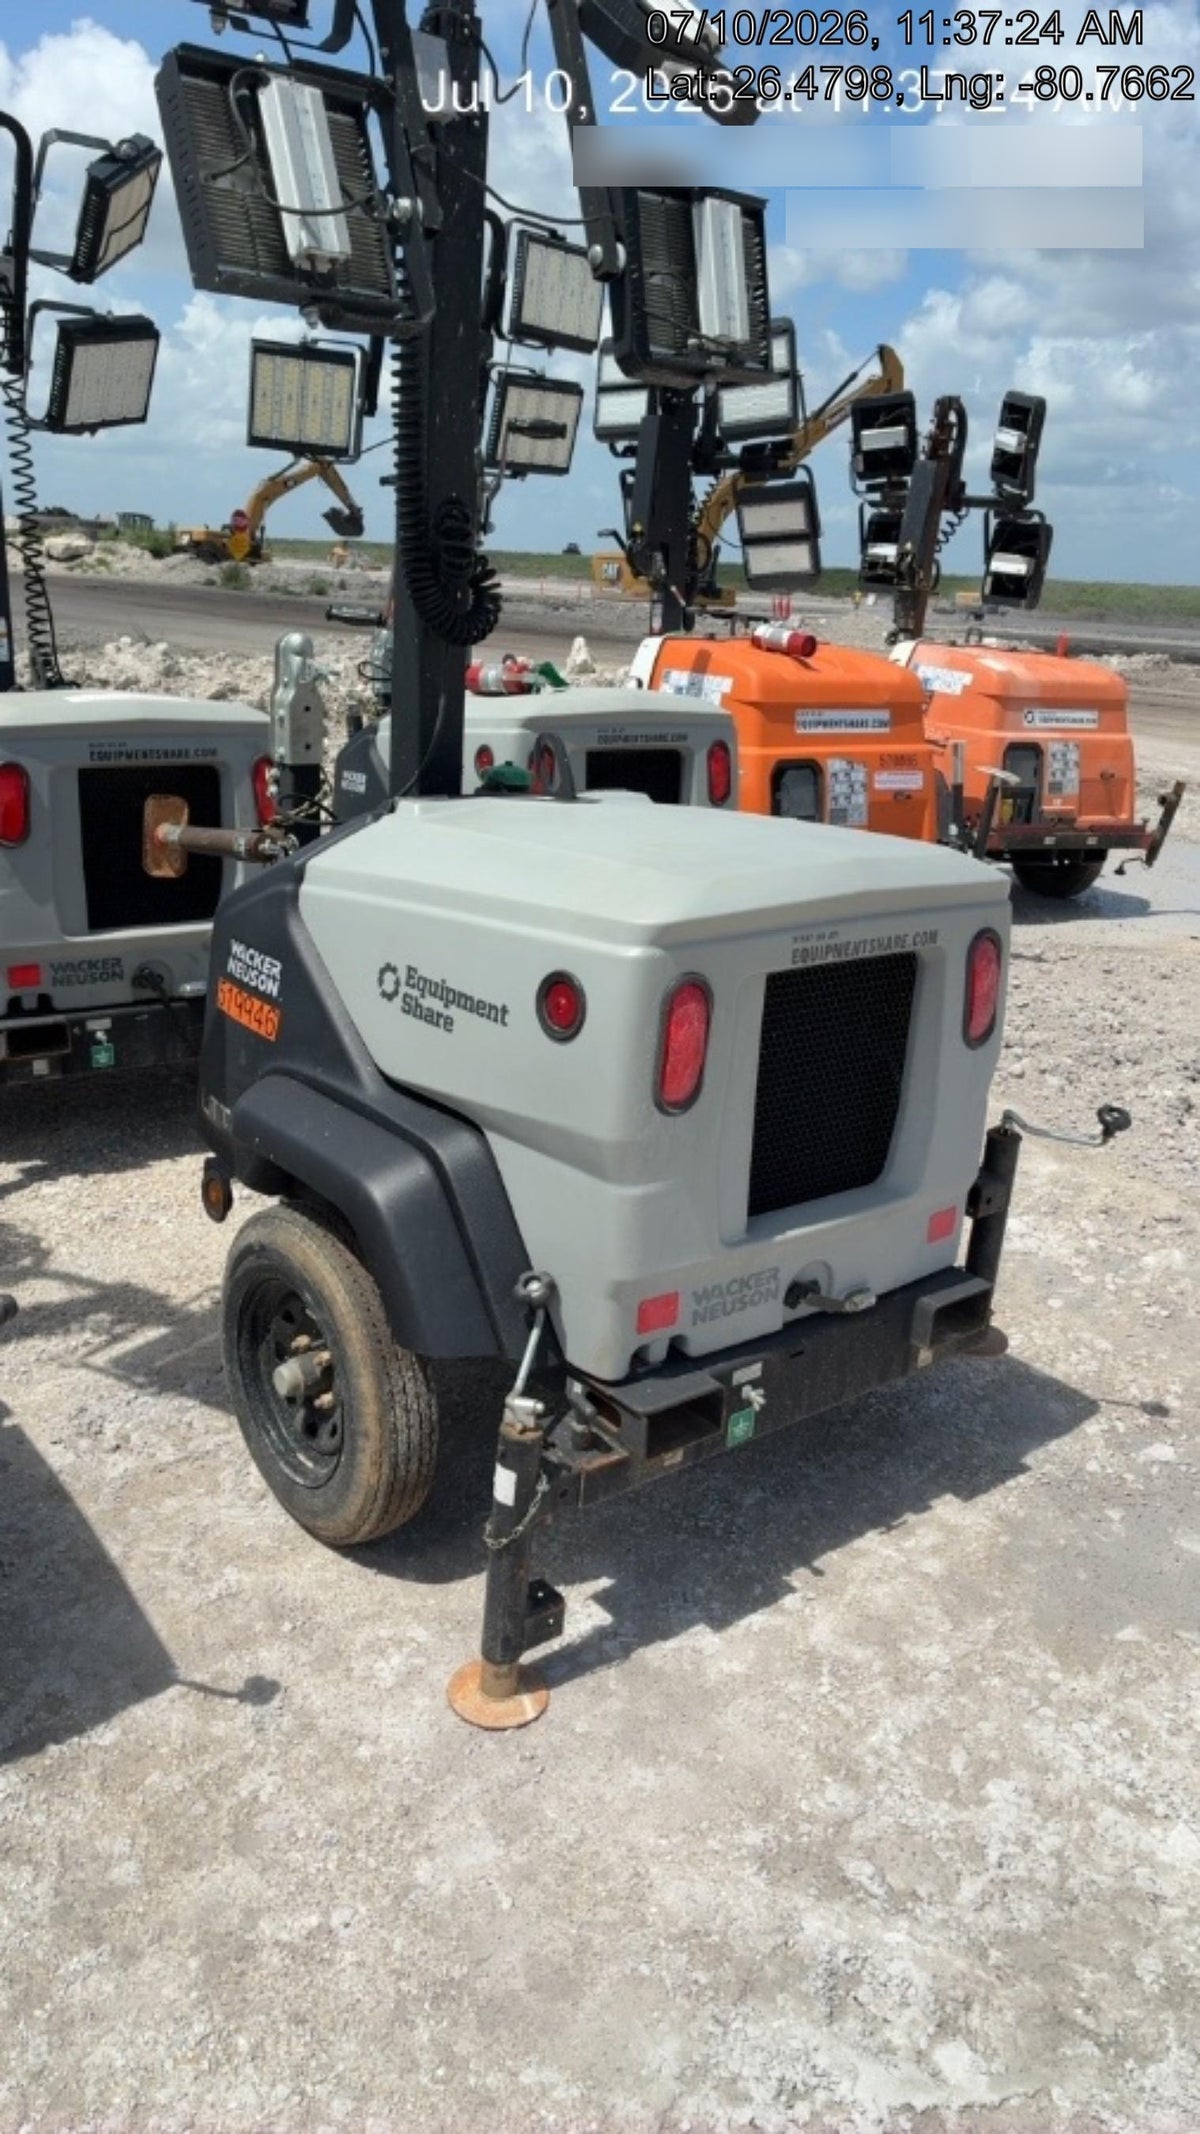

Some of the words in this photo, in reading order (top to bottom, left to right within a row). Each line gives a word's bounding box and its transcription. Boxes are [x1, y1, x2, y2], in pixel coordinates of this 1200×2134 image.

[48, 957, 123, 975] WACKER
[50, 969, 125, 988] NEUSON
[227, 956, 281, 998] NEUSON
[229, 939, 282, 981] WACKER
[401, 991, 454, 1034] Share
[405, 964, 510, 1028] Equipment
[692, 1266, 780, 1306] WACKER
[692, 1285, 780, 1327] NEUSON
